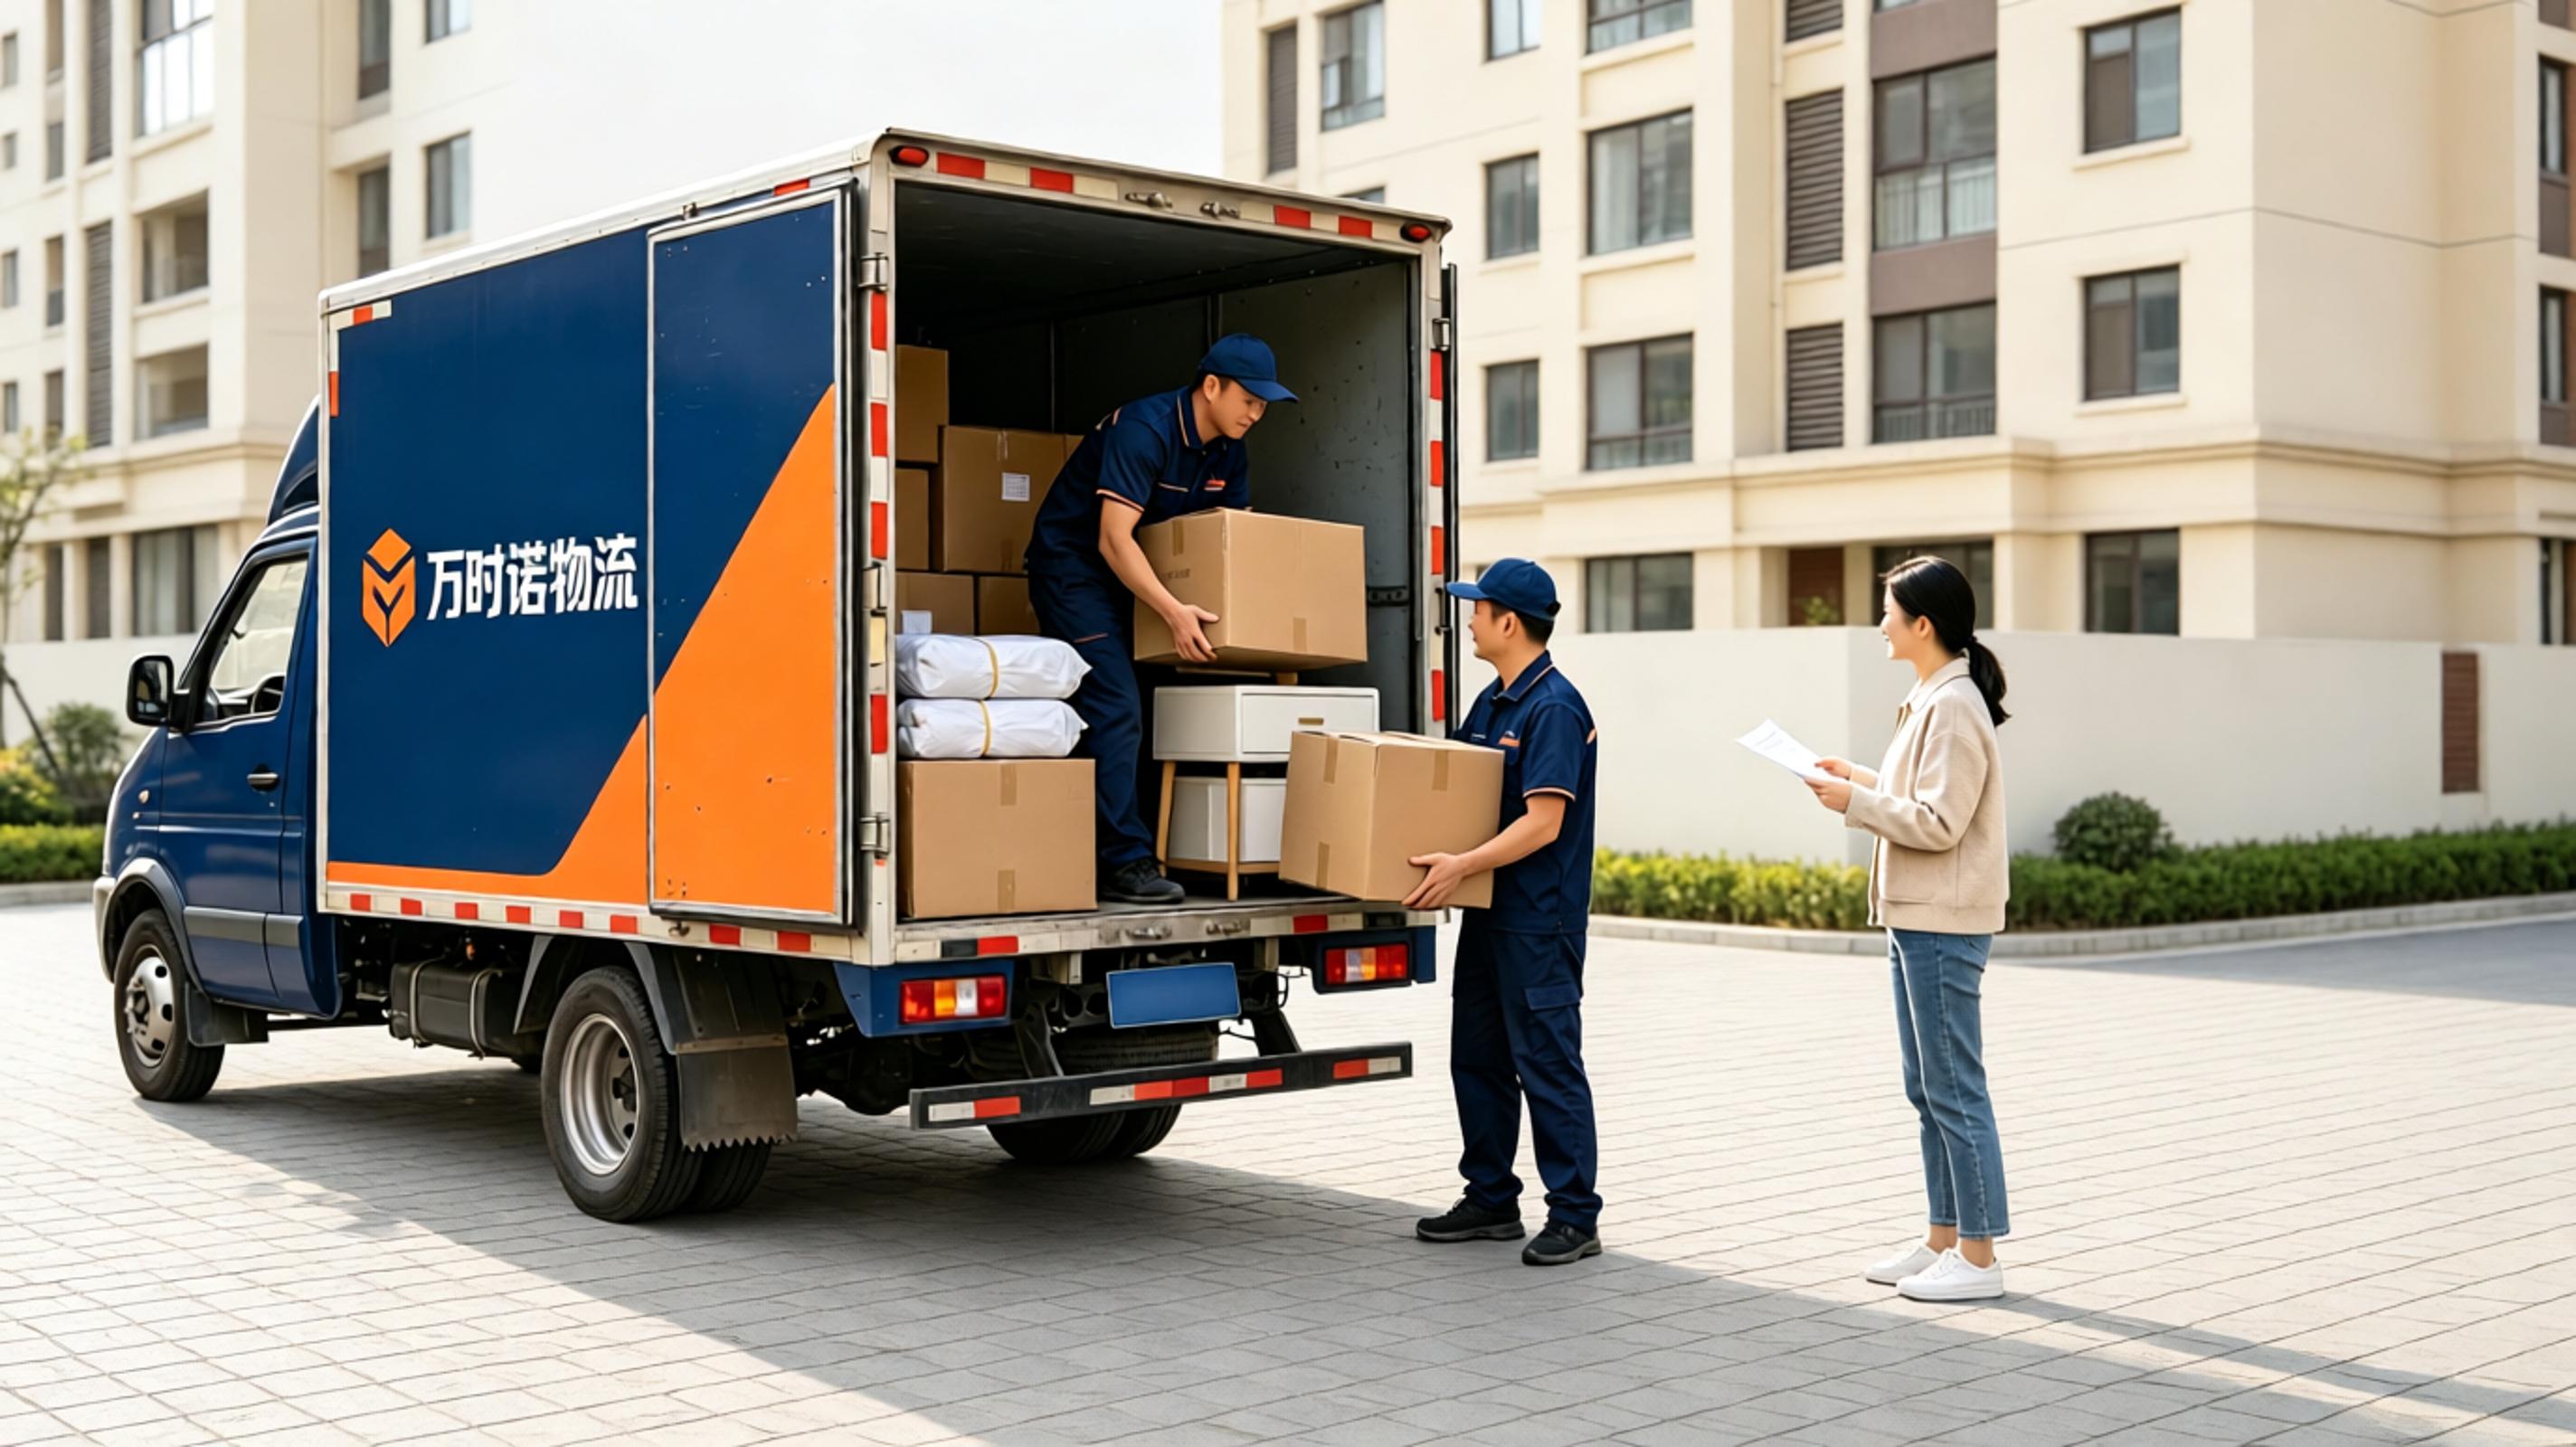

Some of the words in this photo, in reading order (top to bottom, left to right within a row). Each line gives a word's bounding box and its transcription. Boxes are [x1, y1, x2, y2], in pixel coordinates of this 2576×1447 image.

[427, 533, 639, 620] 万时诺物流
